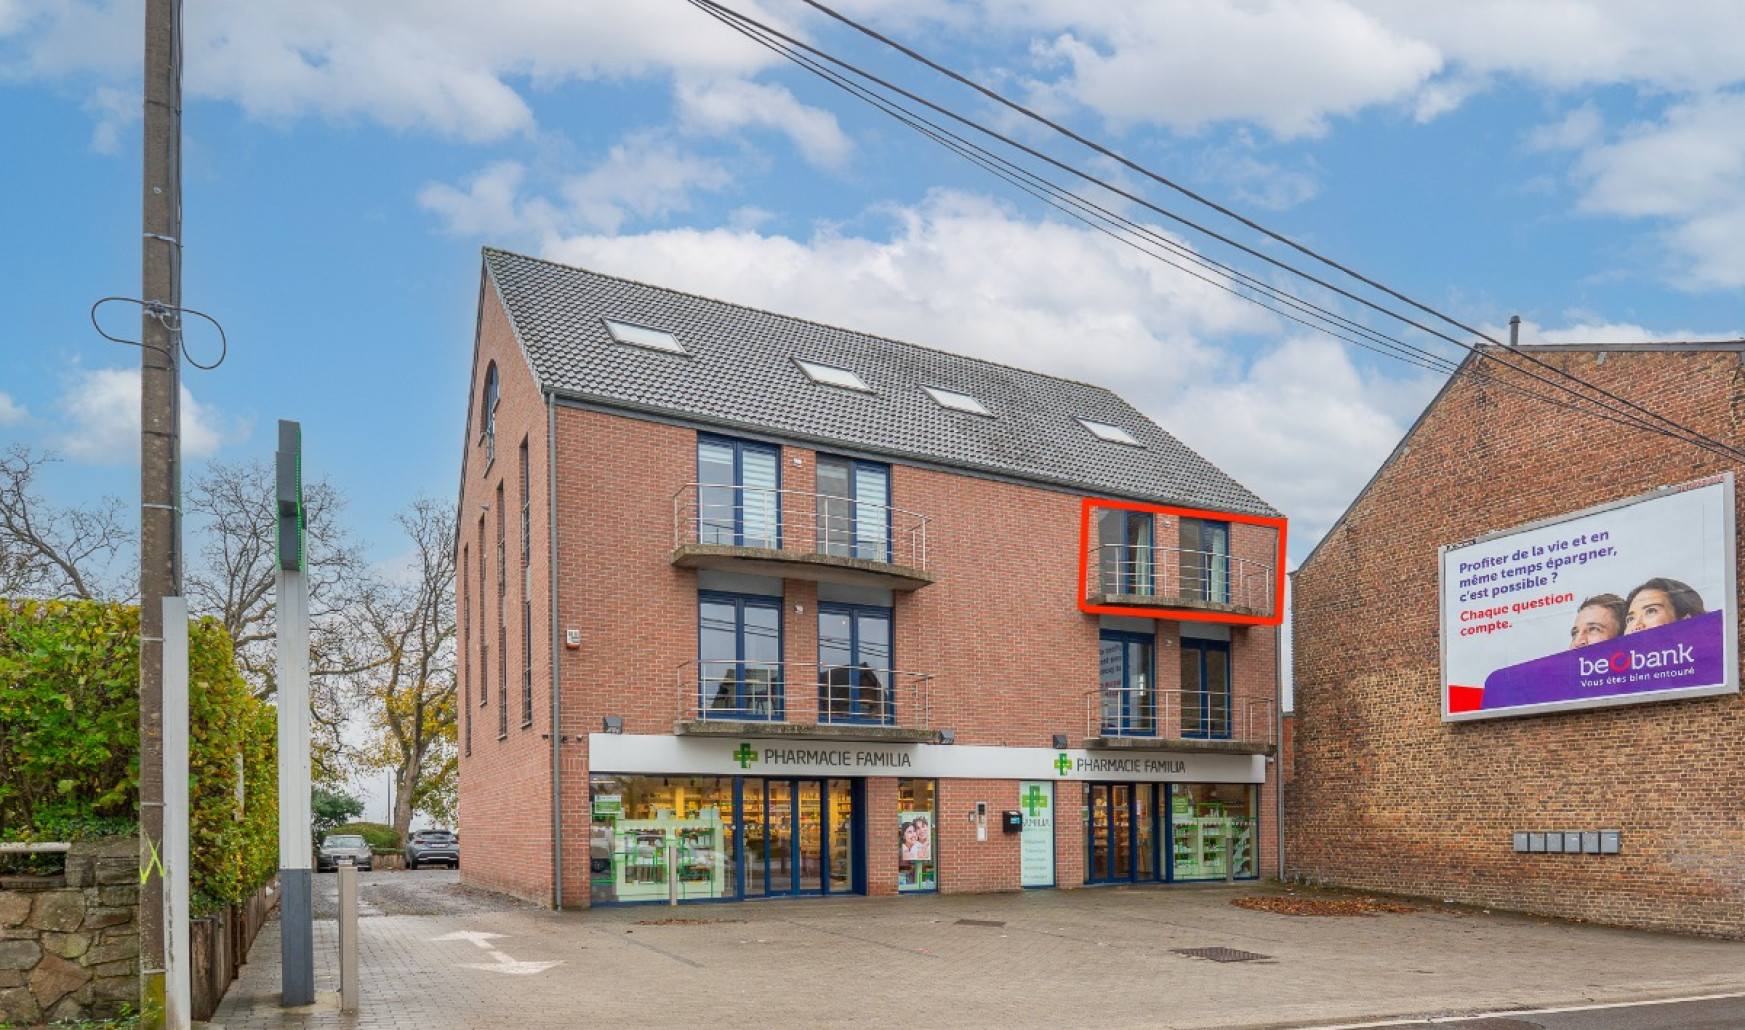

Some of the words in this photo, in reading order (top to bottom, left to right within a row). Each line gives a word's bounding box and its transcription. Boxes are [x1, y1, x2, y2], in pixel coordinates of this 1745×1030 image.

[1459, 555, 1508, 574] Profiter
[1511, 549, 1529, 561] de
[1532, 546, 1544, 557] la
[1547, 540, 1569, 553] vie
[1572, 534, 1587, 547] et
[1590, 531, 1609, 543] en
[1459, 574, 1498, 588] même
[1501, 562, 1543, 578] temps
[1546, 546, 1617, 570] épargner,
[1459, 588, 1489, 601] c'est
[1491, 576, 1548, 598] possible
[1551, 571, 1558, 583] ?
[1460, 605, 1509, 621] Chaque
[1512, 592, 1575, 614] question
[1460, 620, 1513, 636] compte.
[1581, 679, 1604, 688] Vous
[1606, 675, 1627, 685] êtes
[1630, 672, 1650, 682] bien
[1653, 666, 1695, 679] entouré
[764, 748, 851, 766] PHARMACIE
[856, 751, 911, 767] FAMILIA
[1077, 758, 1140, 772] PHARMACIE
[1144, 759, 1186, 773] FAMILIA
